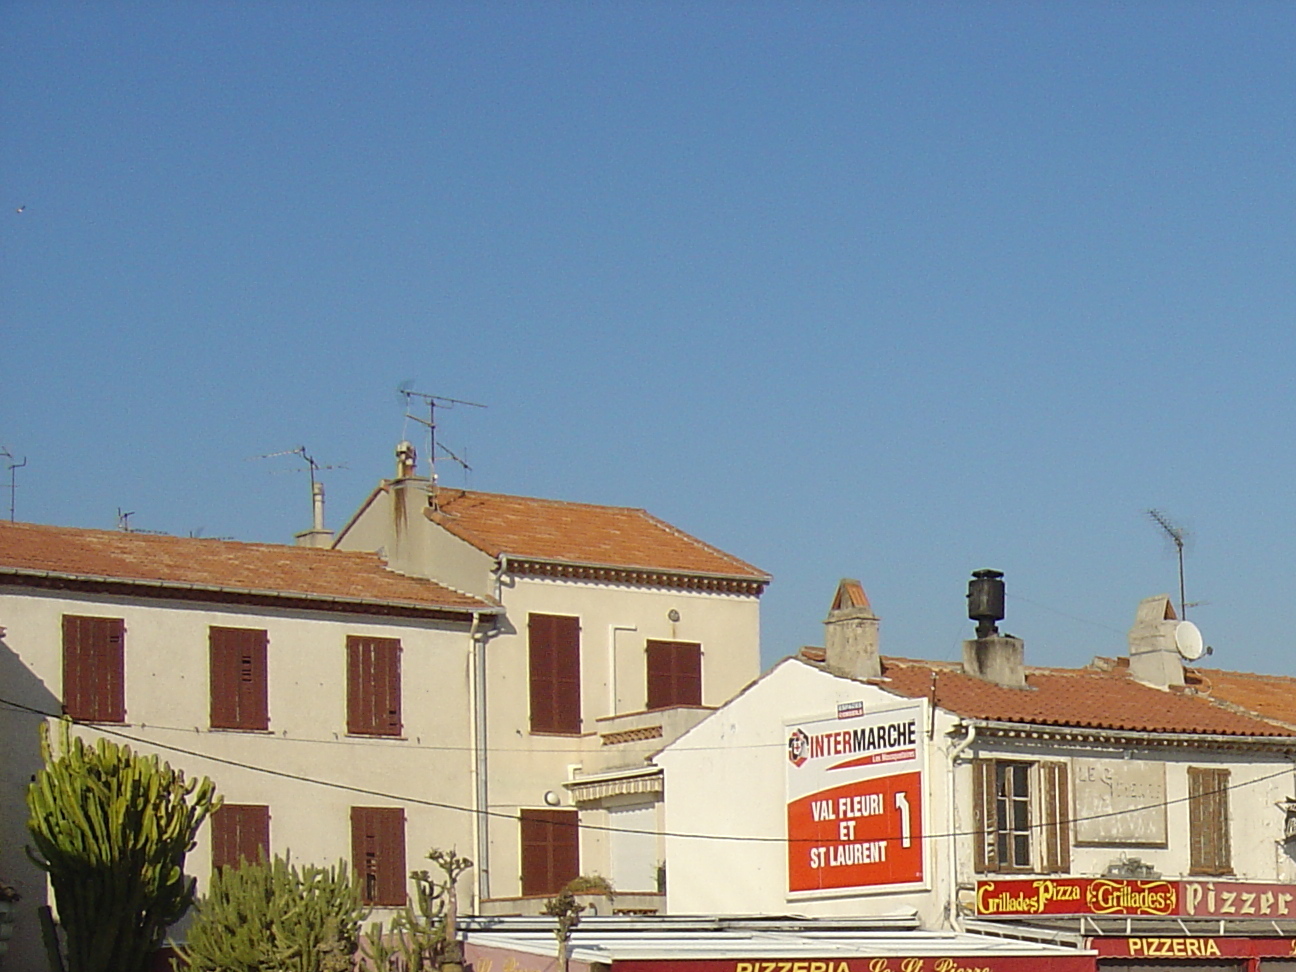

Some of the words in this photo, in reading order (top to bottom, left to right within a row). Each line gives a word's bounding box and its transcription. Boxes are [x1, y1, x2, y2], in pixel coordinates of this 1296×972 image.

[812, 798, 836, 821] VAL
[839, 794, 884, 819] FLEURI
[839, 821, 856, 841] ET
[811, 847, 826, 868] ST
[829, 841, 887, 867] LAURENT
[978, 882, 1038, 913] Grillades
[1033, 880, 1080, 913] Pizza
[1098, 885, 1166, 909] Grillades
[1128, 938, 1221, 956] PIZZERIA
